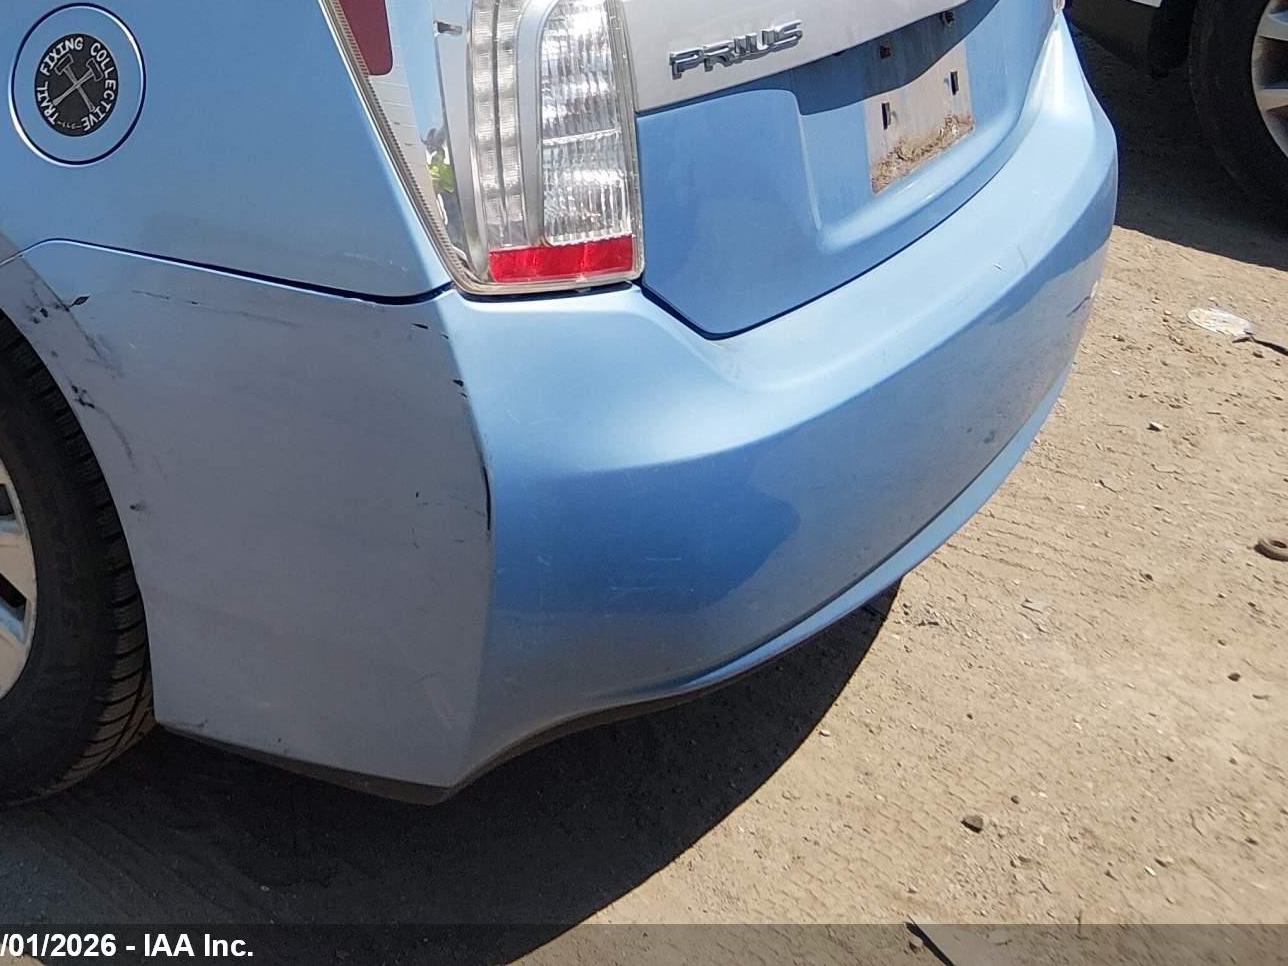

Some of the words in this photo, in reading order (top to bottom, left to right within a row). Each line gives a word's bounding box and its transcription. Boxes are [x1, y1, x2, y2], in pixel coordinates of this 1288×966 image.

[39, 37, 84, 76] FIXING
[669, 19, 804, 80] PRIUS
[36, 81, 61, 126] TRAIL
[81, 42, 118, 132] COLLECTIVE
